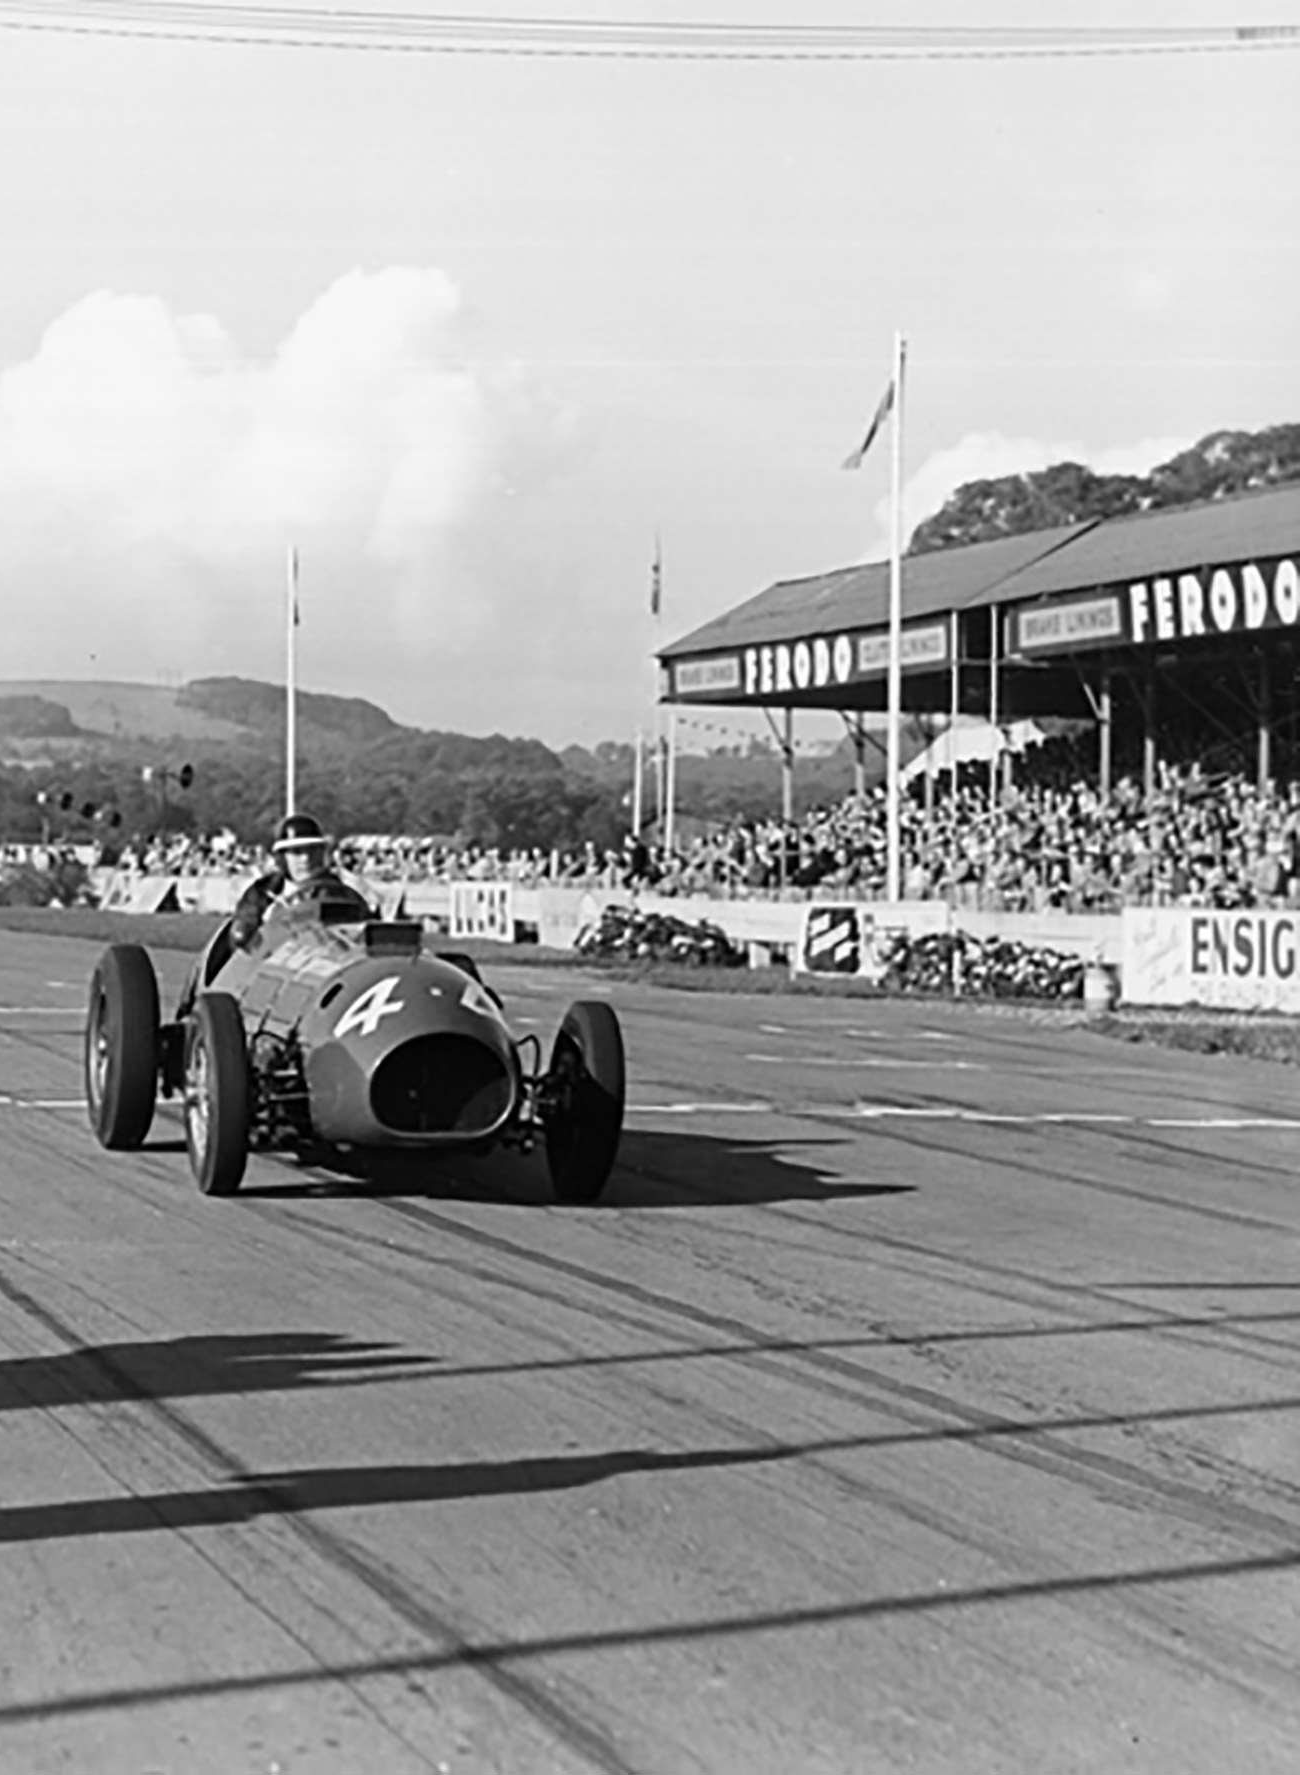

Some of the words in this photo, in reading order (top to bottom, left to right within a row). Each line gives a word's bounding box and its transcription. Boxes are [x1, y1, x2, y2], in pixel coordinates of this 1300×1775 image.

[1129, 560, 1300, 643] FERODO
[745, 635, 851, 694] FERODO
[333, 976, 404, 1038] 4
